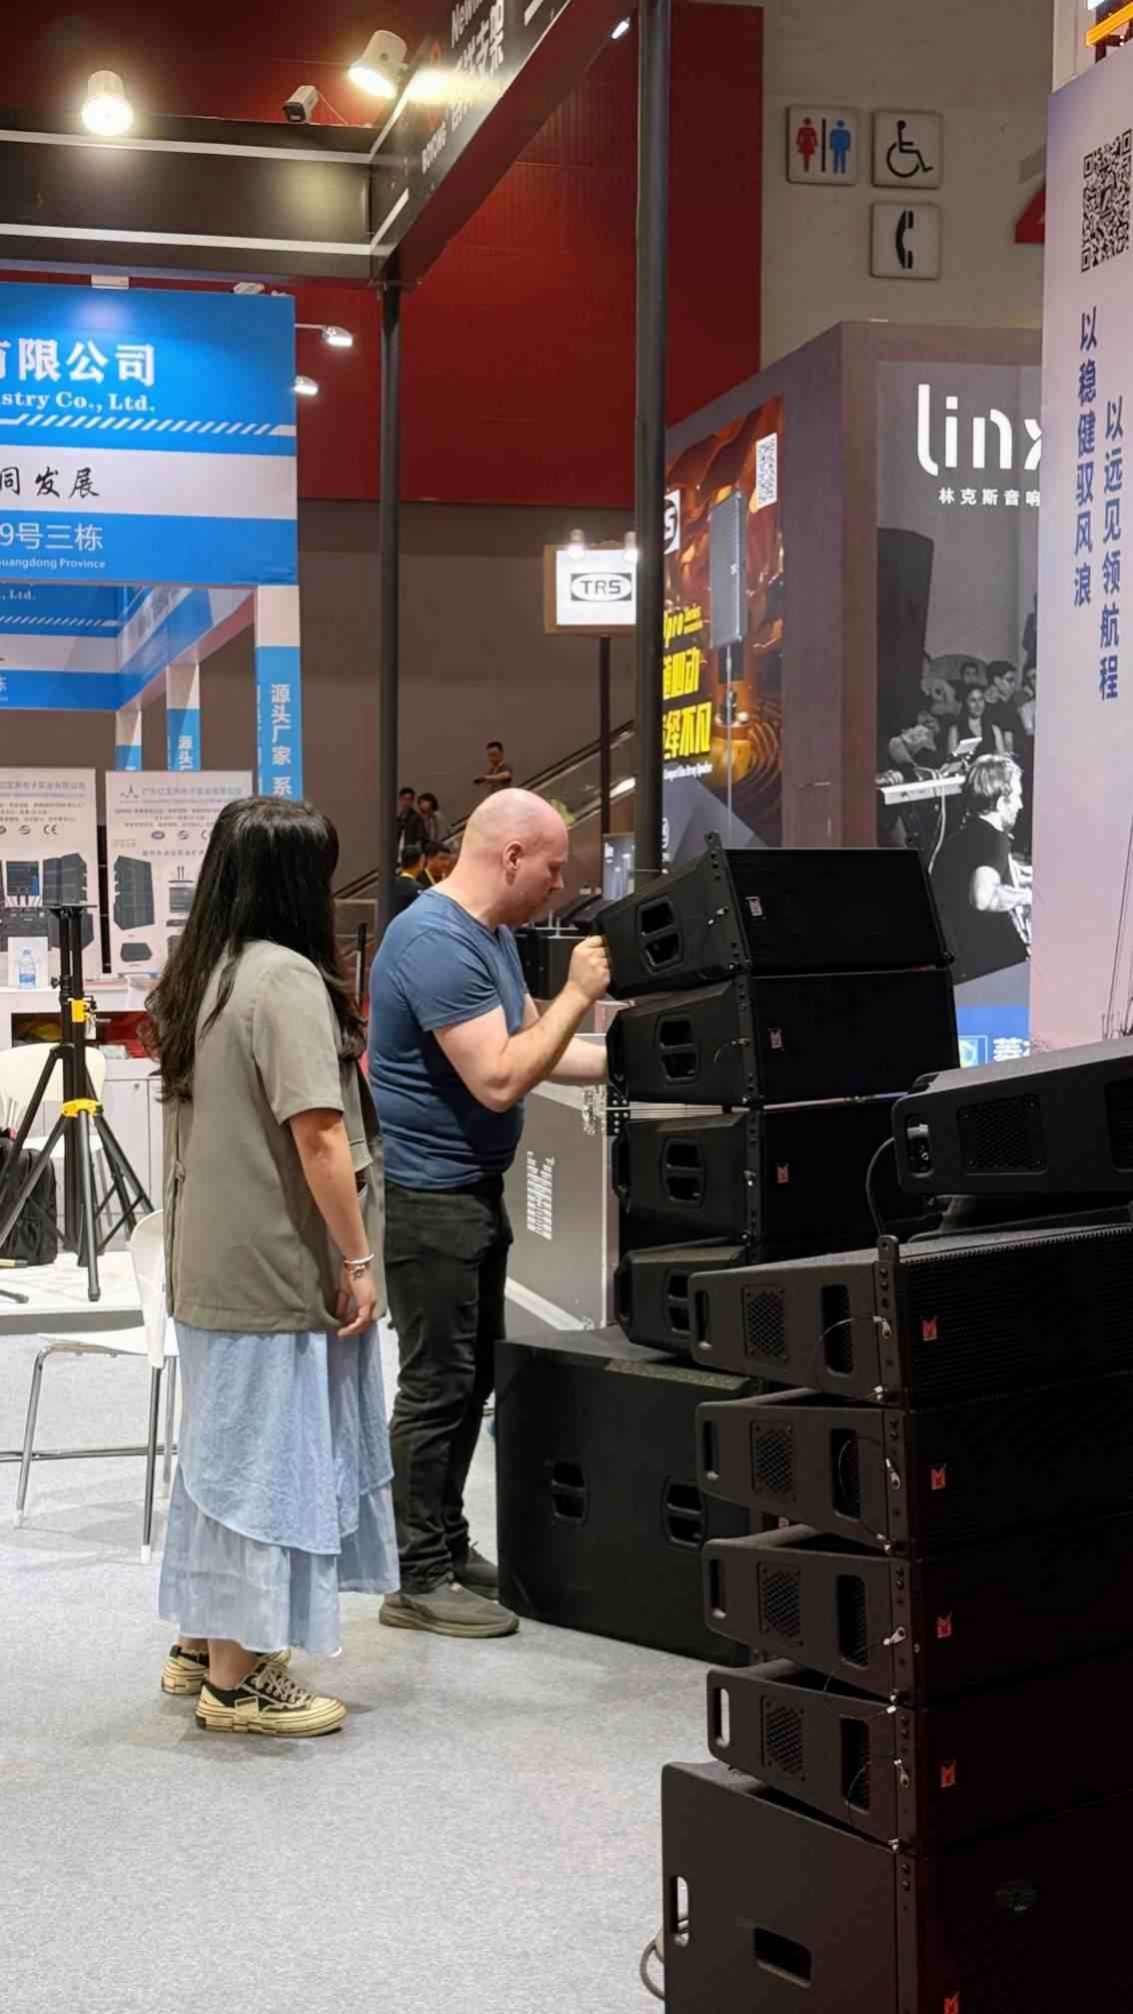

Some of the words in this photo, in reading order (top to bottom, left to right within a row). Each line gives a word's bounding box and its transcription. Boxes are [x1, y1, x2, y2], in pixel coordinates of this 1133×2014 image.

[55, 391, 103, 413] Co.,
[108, 392, 156, 412] Ltd.
[1074, 305, 1097, 608] 以稳健驭风浪
[0, 521, 104, 552] 9号三栋
[1099, 394, 1124, 701] 以远见领航程
[0, 556, 57, 570] uangdong
[60, 557, 105, 569] Province
[580, 579, 621, 596] TRS
